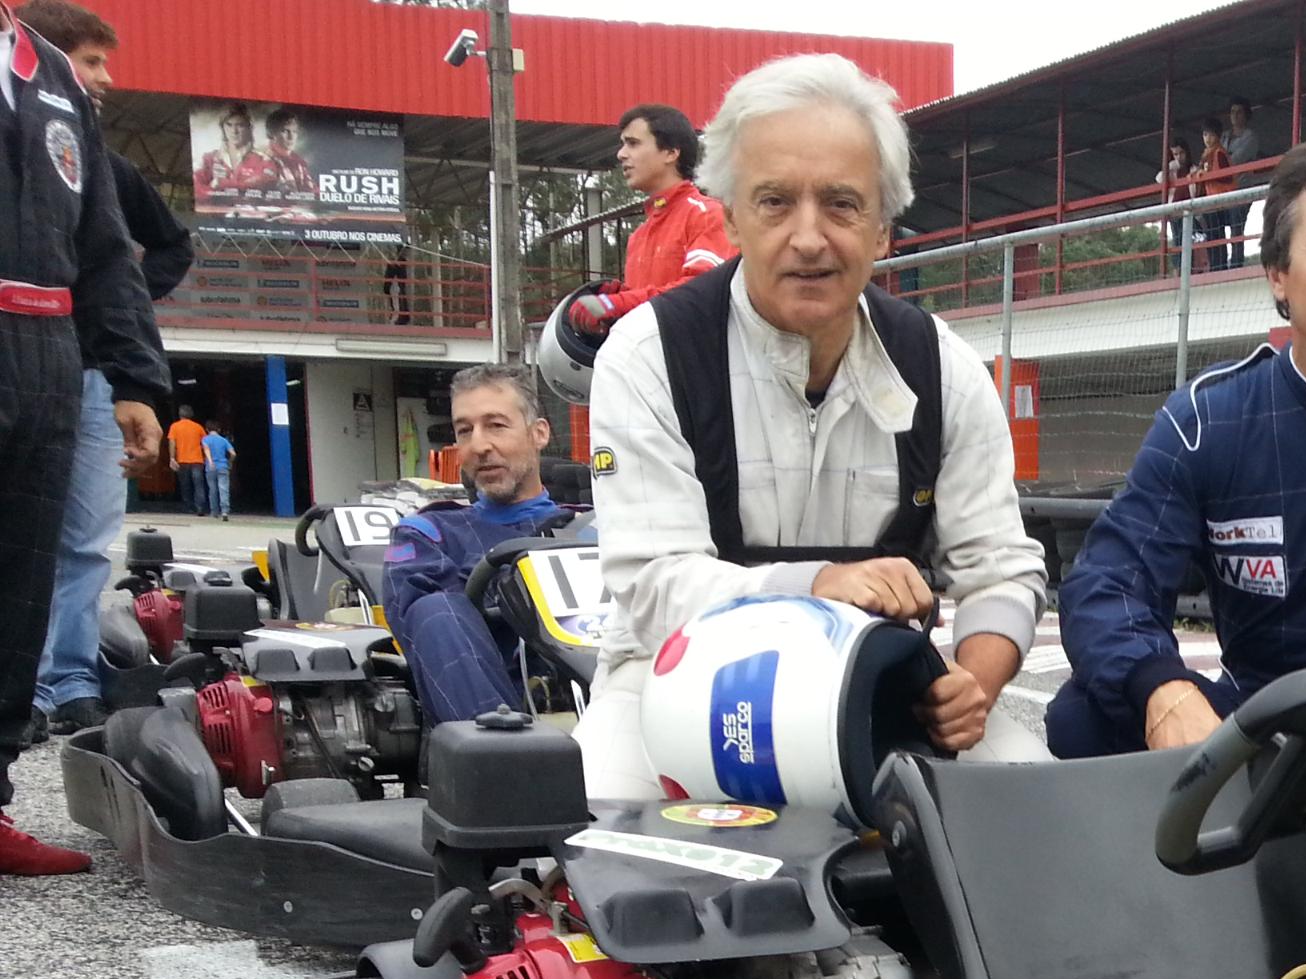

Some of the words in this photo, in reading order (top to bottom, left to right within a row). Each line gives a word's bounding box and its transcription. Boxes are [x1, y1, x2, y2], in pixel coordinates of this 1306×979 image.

[319, 174, 399, 195] RUSH
[320, 192, 352, 203] DUELO
[354, 193, 367, 203] DE
[369, 194, 400, 205] RIVAIS
[304, 230, 310, 238] 3
[311, 230, 347, 240] OUTUBRO
[349, 231, 365, 241] NOS
[367, 232, 402, 242] CINEMAS
[344, 510, 394, 541] 19
[736, 700, 754, 764] sparco
